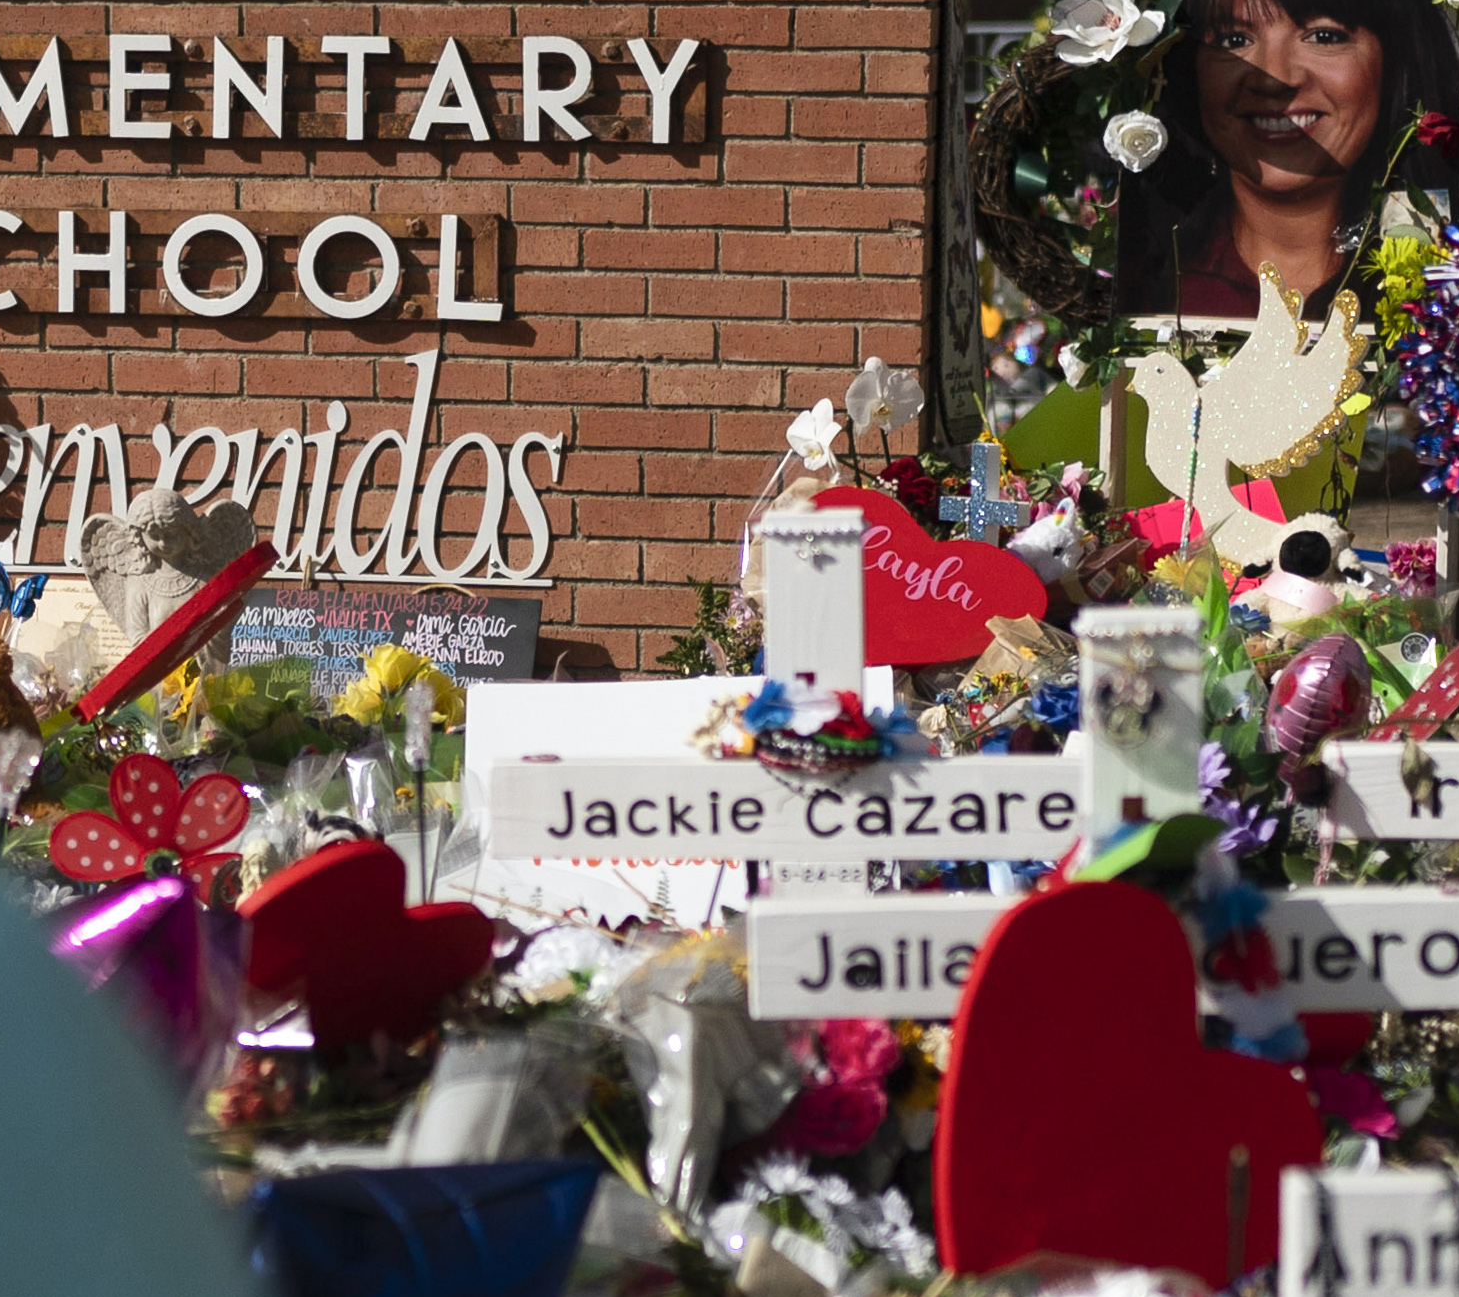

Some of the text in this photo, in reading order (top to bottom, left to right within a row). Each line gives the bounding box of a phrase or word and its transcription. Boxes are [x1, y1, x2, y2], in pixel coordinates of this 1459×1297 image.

[861, 525, 982, 611] Layla
[275, 588, 319, 609] ROBB
[323, 590, 427, 615] ELEMENTARY
[323, 609, 368, 630] UVALDE
[373, 610, 394, 631] TX
[416, 613, 454, 635] Irma
[458, 614, 517, 638] Garcia
[270, 626, 310, 642] GARCIA
[317, 627, 356, 644] XAVIER
[401, 631, 444, 650] AMERIE
[448, 633, 486, 651] GARZA
[281, 639, 325, 657] TORRES
[329, 641, 361, 658] TESS
[465, 649, 505, 667] ELROD
[318, 655, 358, 672] FLORES
[547, 785, 1078, 840] Jackie Cazare
[779, 868, 863, 883] 5-24-22
[799, 933, 977, 992] Jaila
